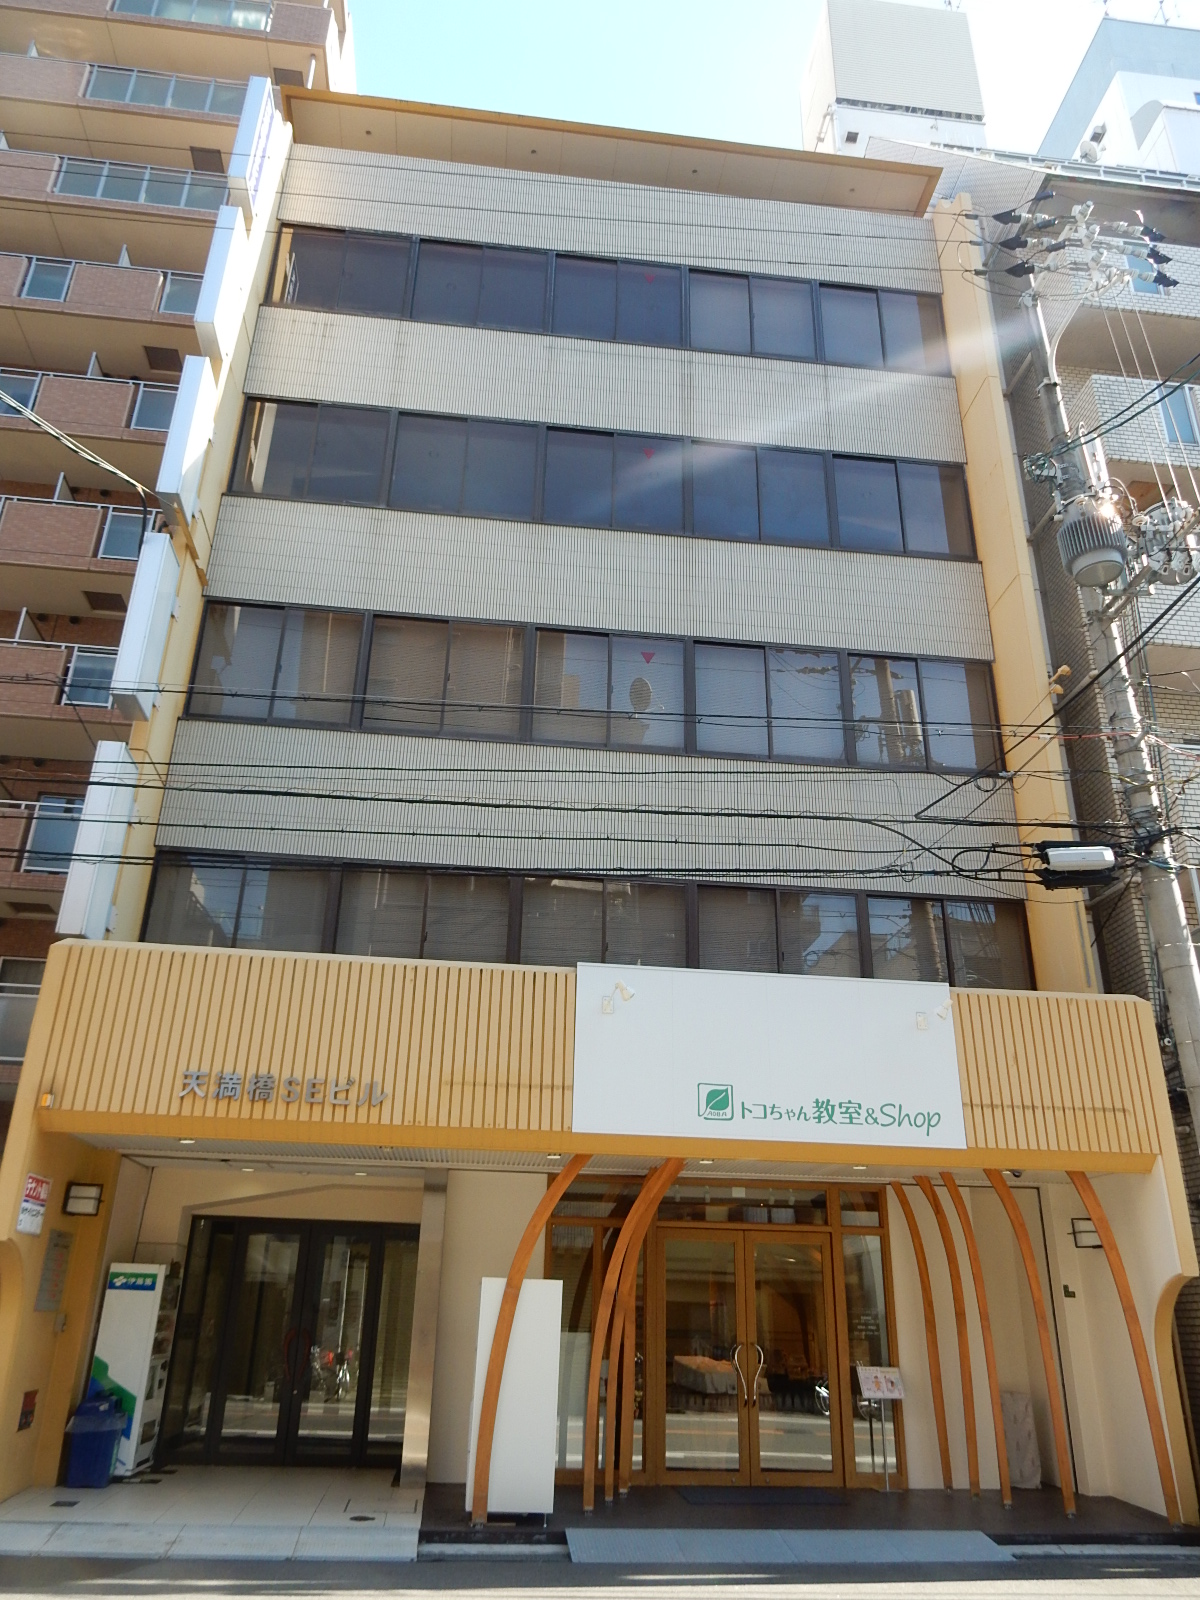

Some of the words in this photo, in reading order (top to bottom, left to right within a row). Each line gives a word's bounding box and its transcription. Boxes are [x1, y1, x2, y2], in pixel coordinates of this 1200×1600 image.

[178, 1069, 389, 1108] 天満橋SEビル
[741, 1098, 941, 1136] トコちゃん教室&Shop
